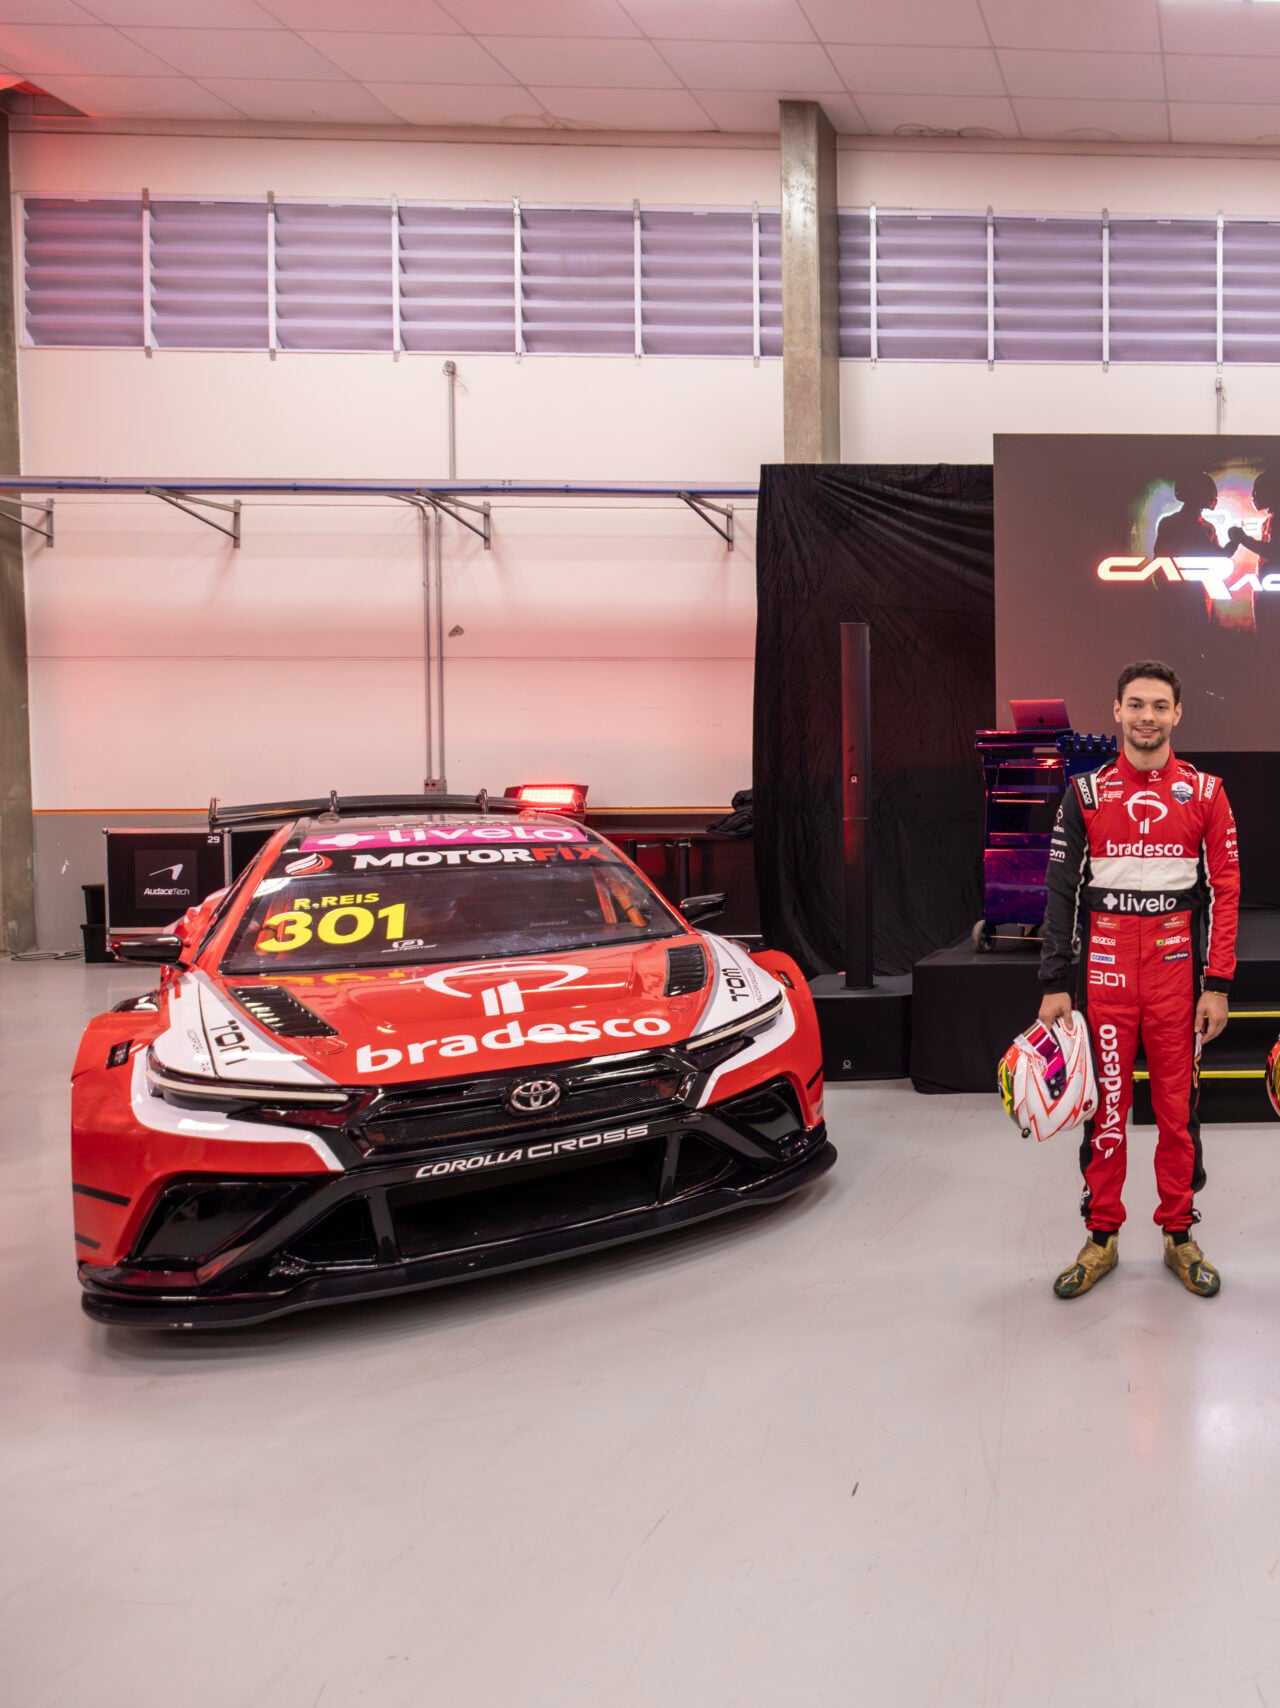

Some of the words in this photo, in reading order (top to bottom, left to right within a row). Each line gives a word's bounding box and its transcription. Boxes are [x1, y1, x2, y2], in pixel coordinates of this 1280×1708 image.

[388, 826, 574, 843] livelo
[351, 846, 608, 869] MOTORFIX
[1106, 840, 1184, 856] bradesco
[143, 887, 190, 896] AudaceTech
[293, 892, 380, 911] R.REIS
[1119, 893, 1177, 912] livelo
[258, 902, 406, 952] 301
[1090, 970, 1126, 988] 301
[356, 1017, 671, 1073] bradesco
[1099, 1023, 1122, 1130] bradesco
[415, 1149, 523, 1179] COROLLA
[528, 1125, 649, 1159] CROSS
